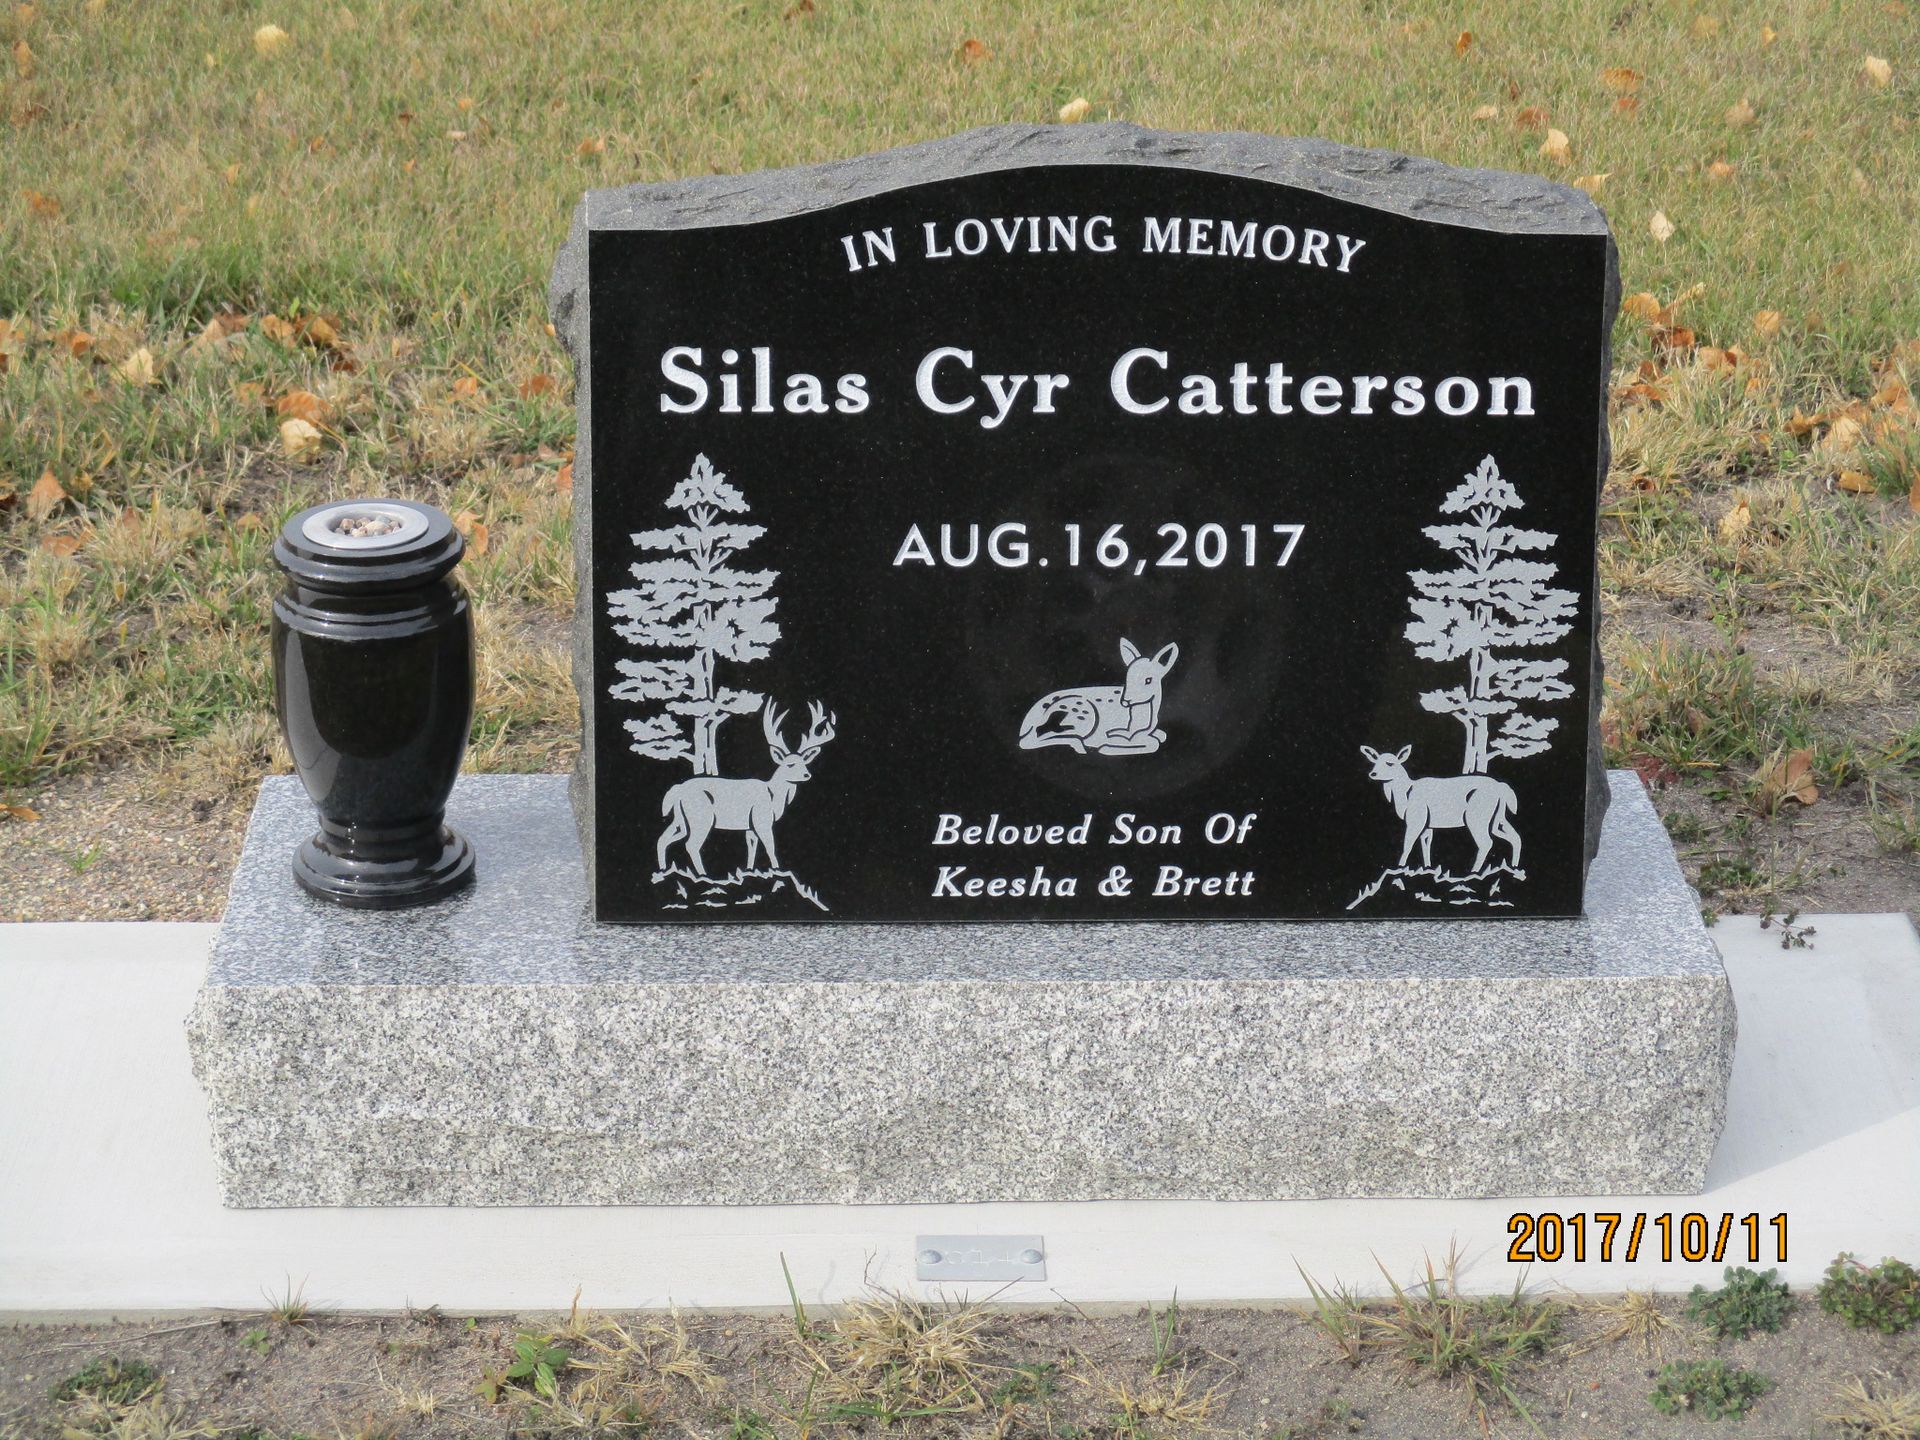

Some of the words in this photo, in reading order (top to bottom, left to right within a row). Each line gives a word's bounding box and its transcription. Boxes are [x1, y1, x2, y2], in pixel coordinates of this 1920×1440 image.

[841, 227, 896, 272] IN
[922, 215, 1118, 259] LOVING
[1142, 216, 1367, 273] MEMORY
[660, 346, 870, 415] Silas
[915, 347, 1070, 430] Cyr
[1110, 348, 1536, 416] Catterson
[931, 813, 1093, 845] Beloved
[1108, 813, 1182, 845] Son
[1204, 813, 1258, 844] Of
[931, 865, 1078, 898] Keesha
[1097, 865, 1133, 897] &
[1151, 865, 1256, 897] Brett
